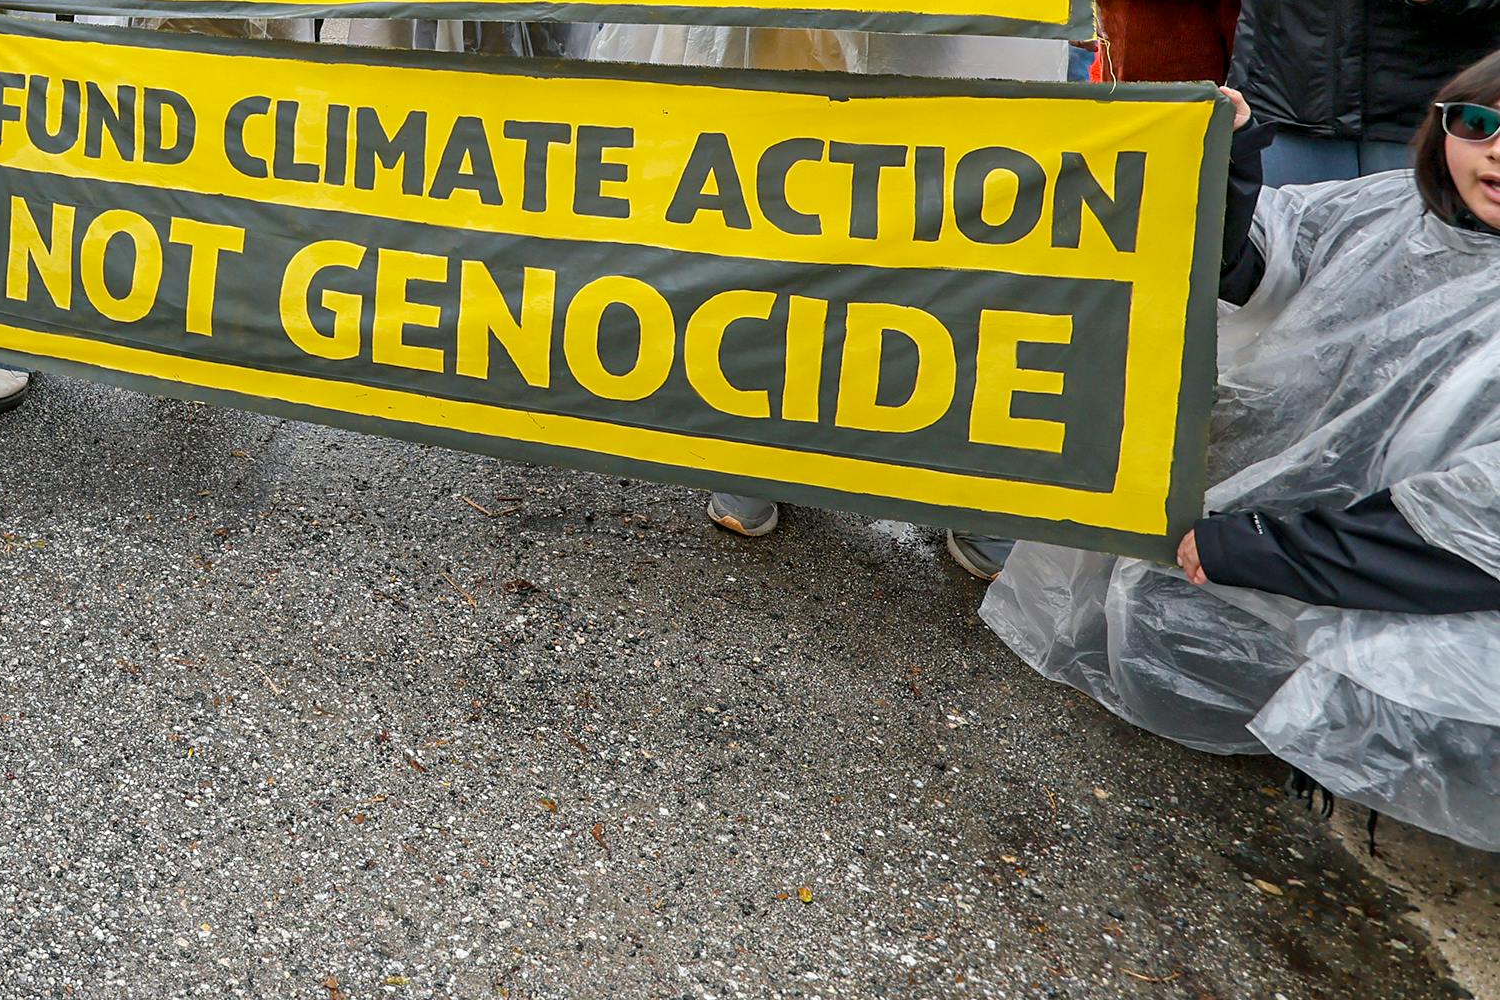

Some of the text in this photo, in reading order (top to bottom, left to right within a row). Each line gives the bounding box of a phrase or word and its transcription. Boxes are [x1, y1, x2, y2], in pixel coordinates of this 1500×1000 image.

[224, 95, 634, 219] CLIMATE
[665, 131, 1147, 253] ACTION
[6, 196, 1074, 453] NOT GENOCIDE
